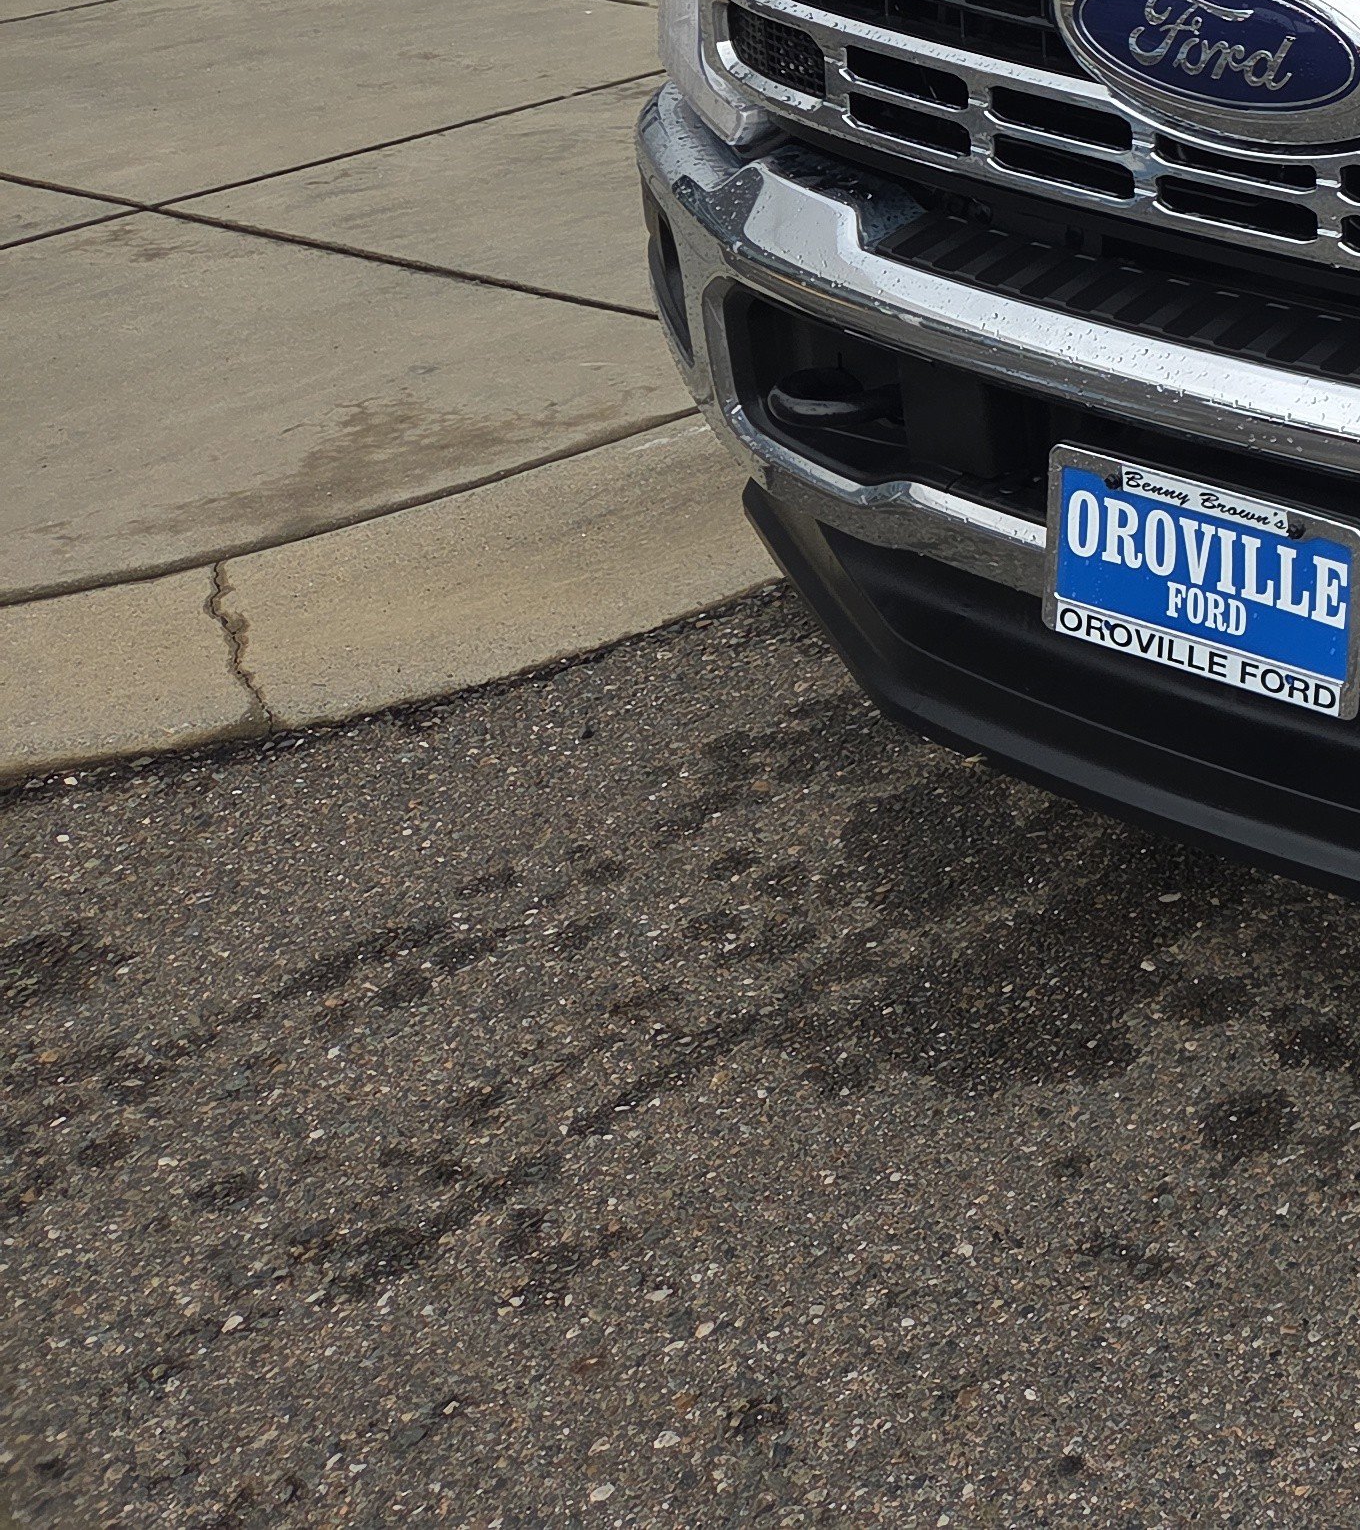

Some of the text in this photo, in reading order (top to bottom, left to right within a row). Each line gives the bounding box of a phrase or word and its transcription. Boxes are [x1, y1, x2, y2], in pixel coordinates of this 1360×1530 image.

[1124, 470, 1287, 532] Benny Brown's
[1066, 489, 1349, 630] OROVILLE
[1165, 580, 1248, 637] FORD
[1059, 606, 1338, 711] OROVILLE FORD
